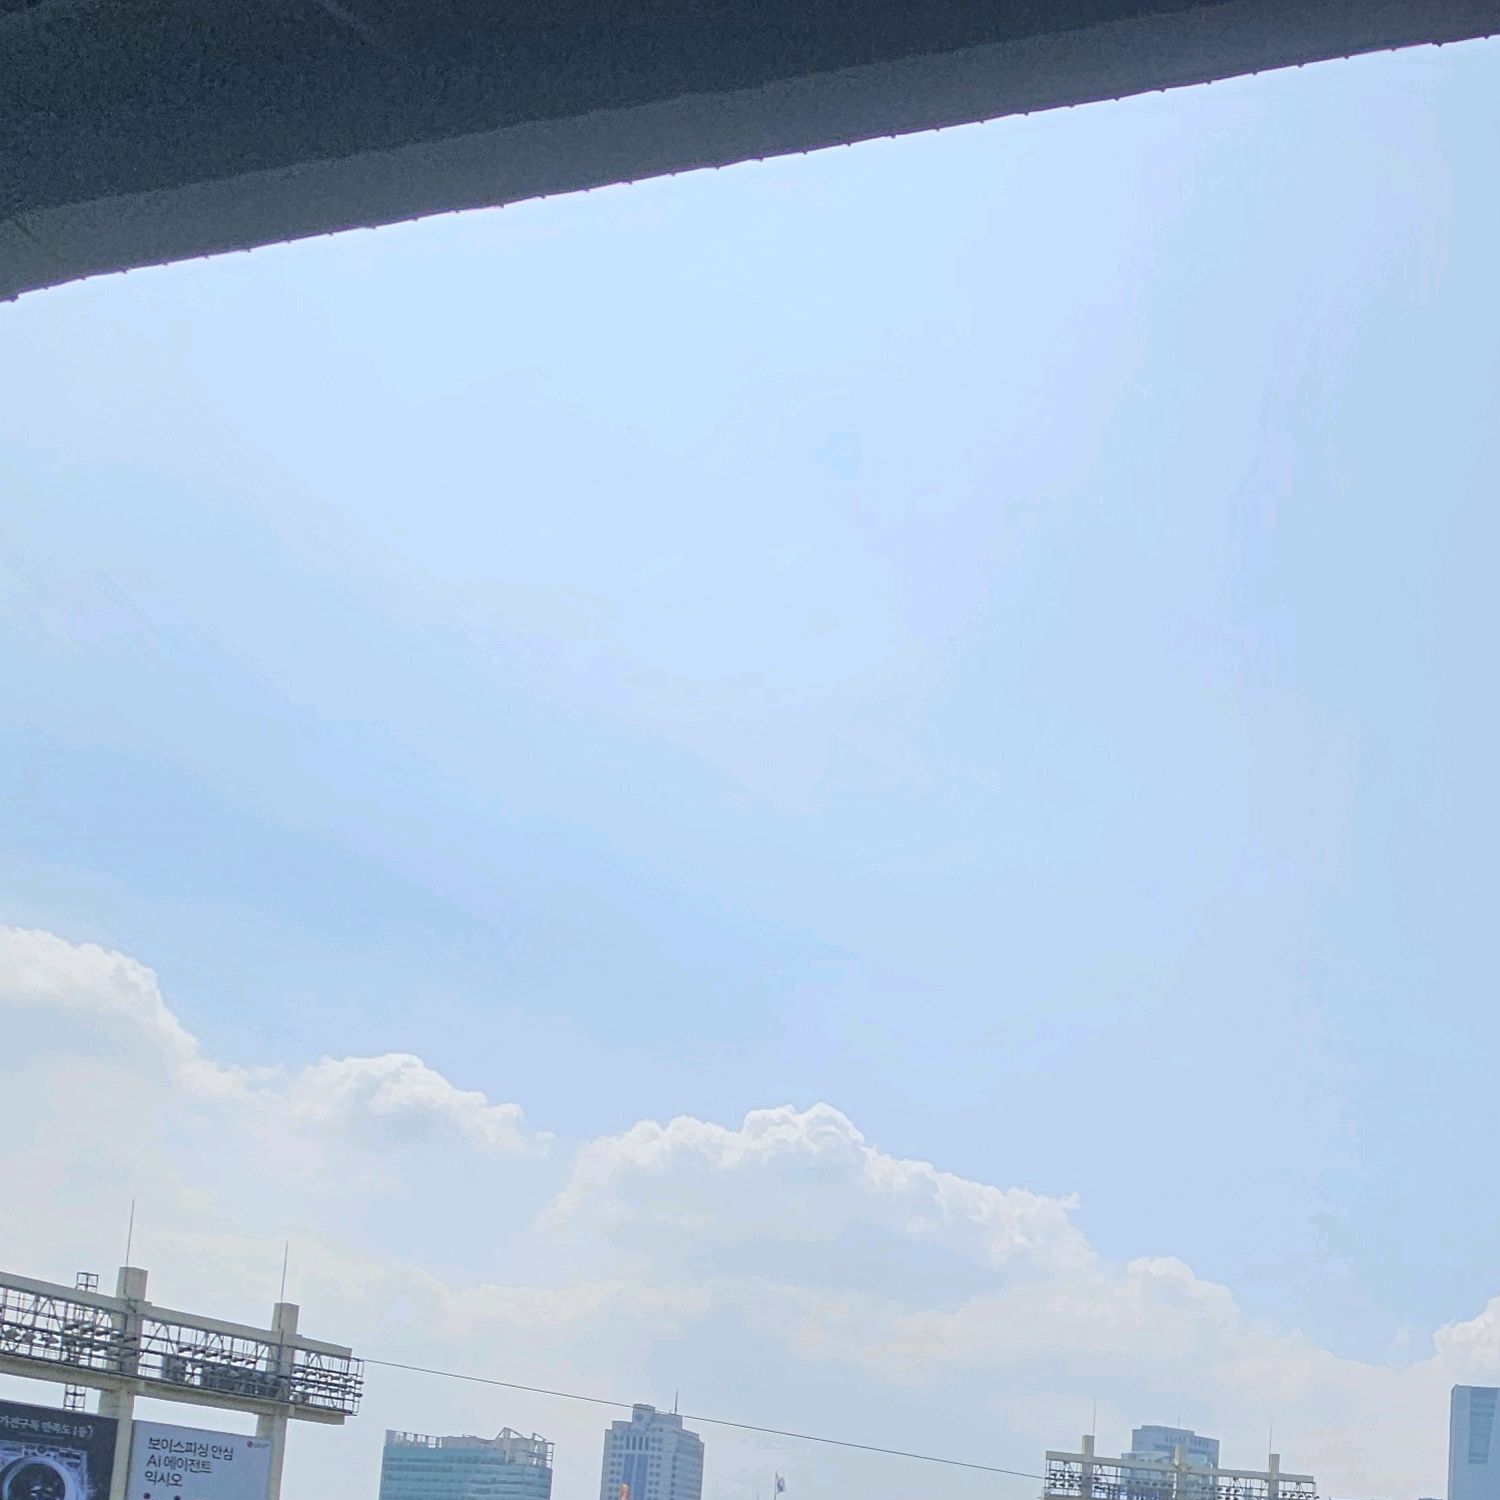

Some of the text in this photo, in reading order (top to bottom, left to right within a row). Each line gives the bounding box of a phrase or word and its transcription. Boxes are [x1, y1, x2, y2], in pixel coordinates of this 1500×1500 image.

[148, 1437, 234, 1461] 보이스피싱 안심
[146, 1454, 213, 1474] AI 에이전트
[144, 1471, 183, 1488] 익시오
